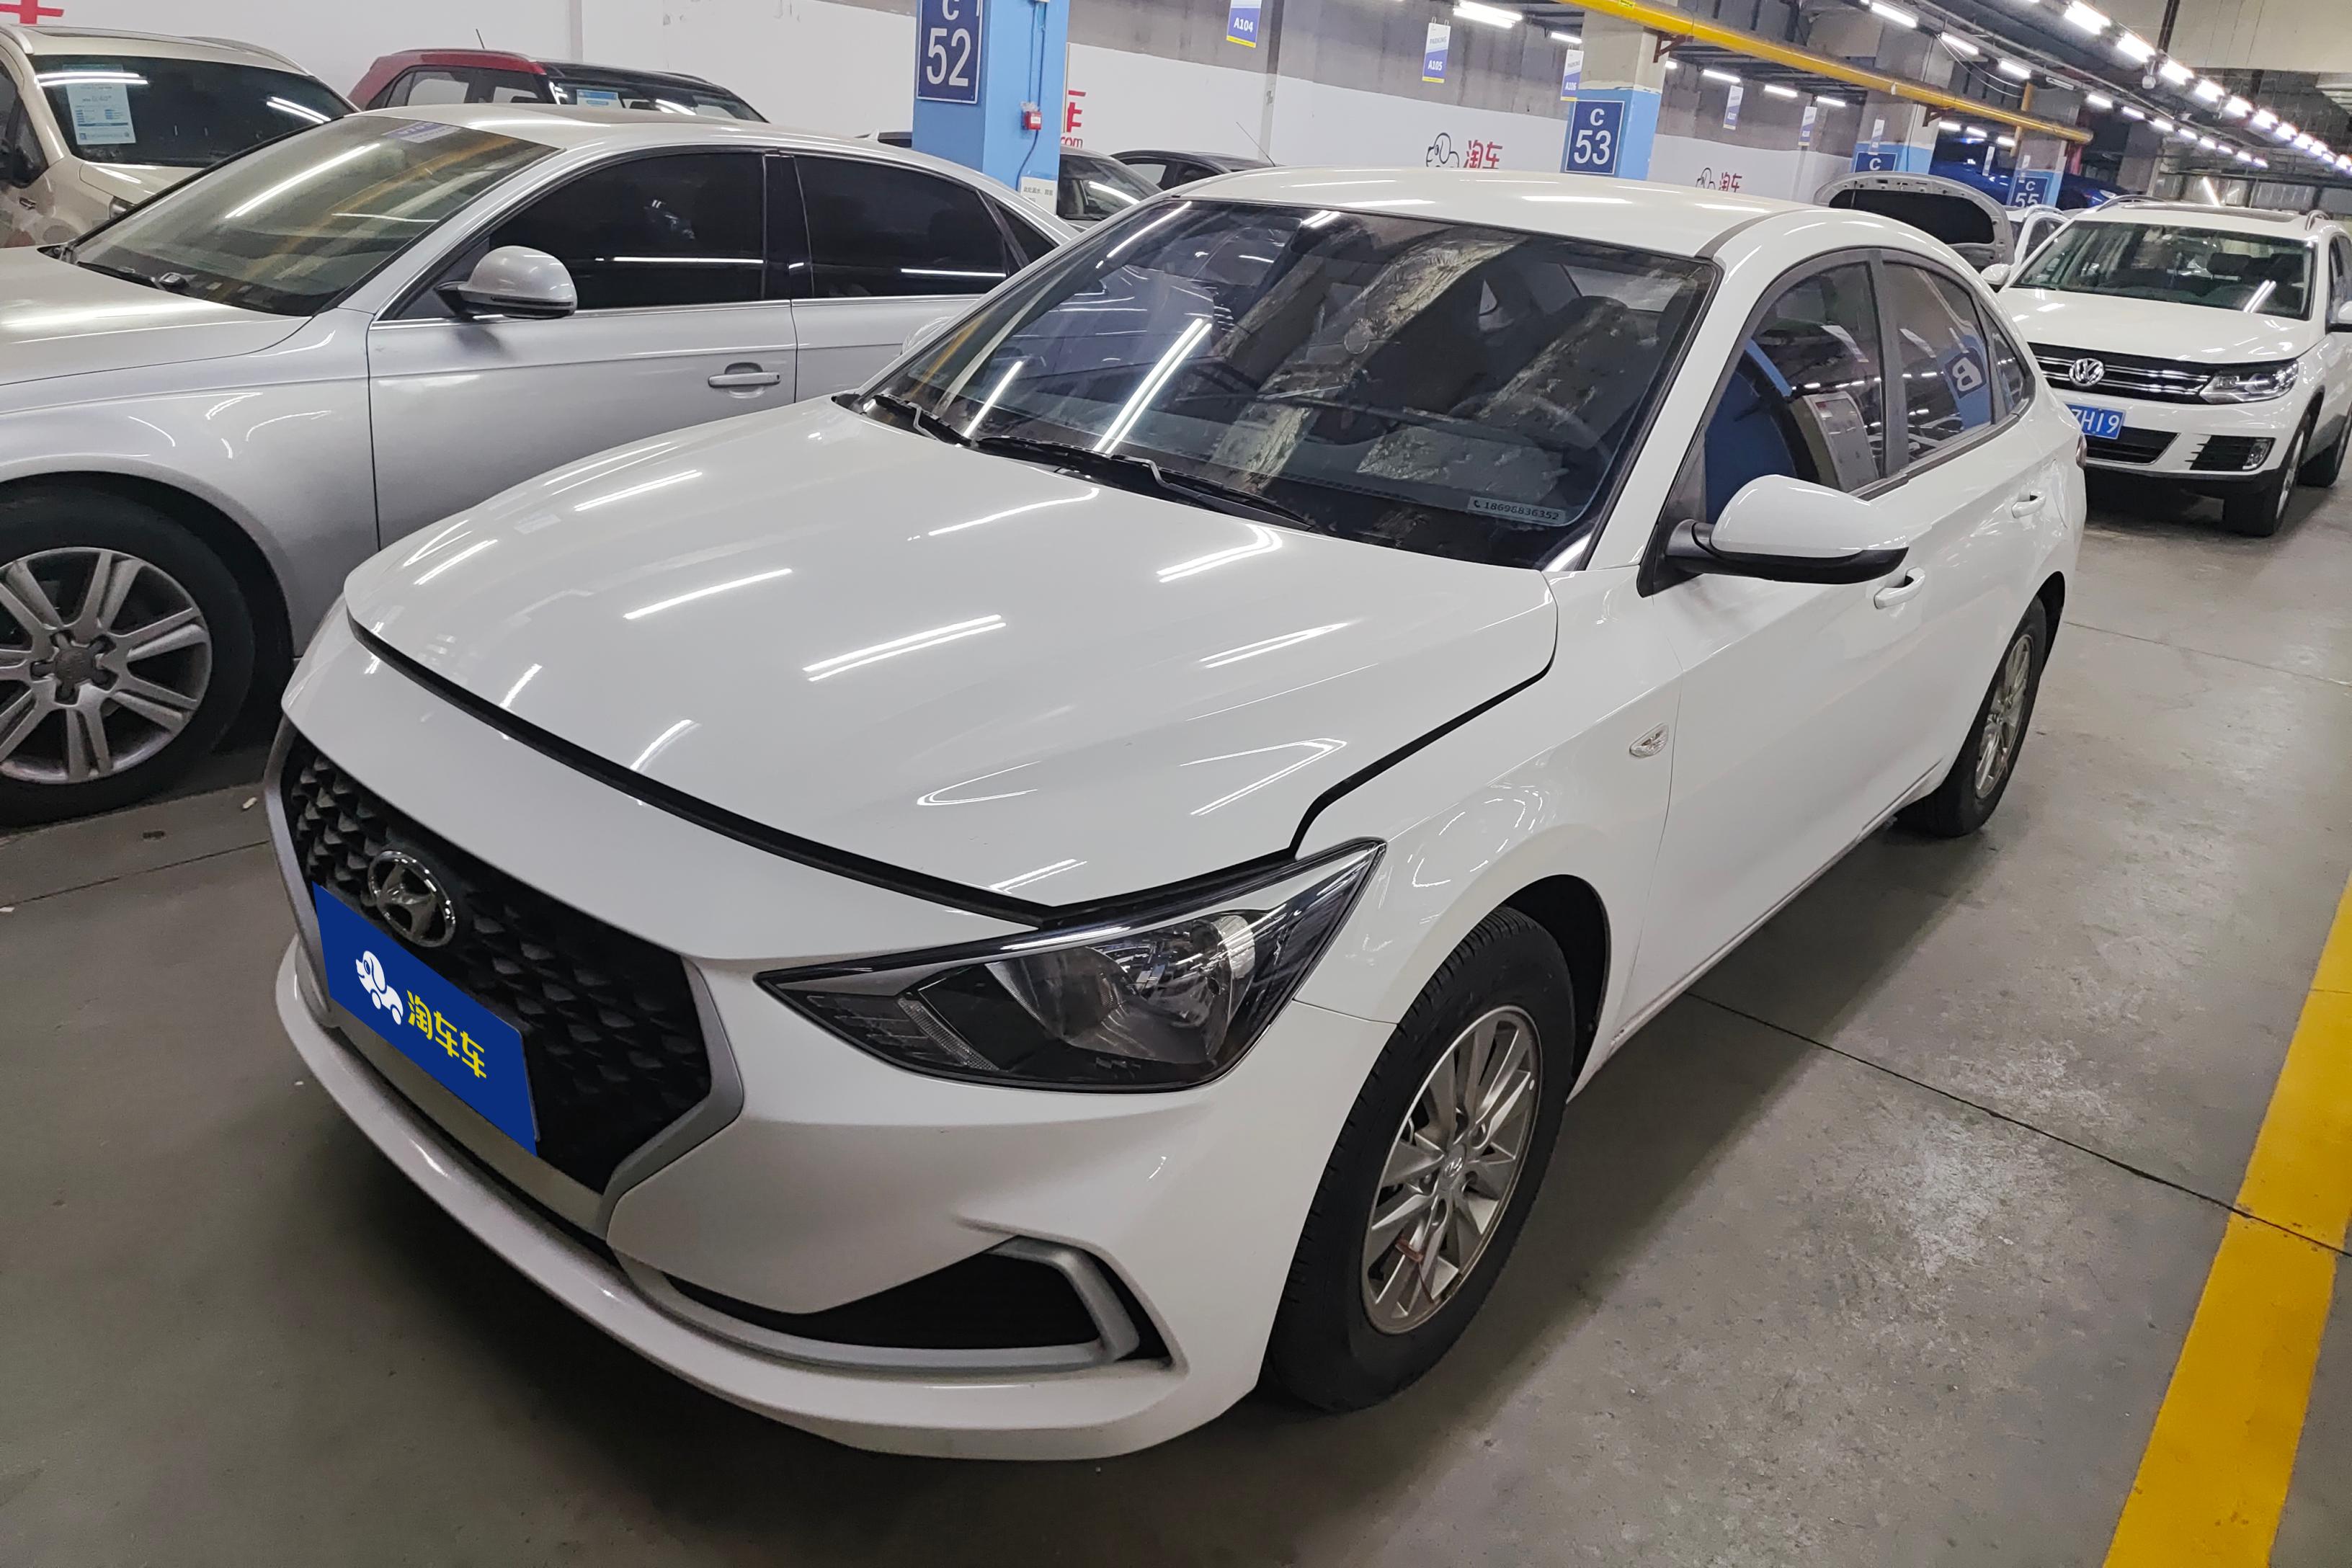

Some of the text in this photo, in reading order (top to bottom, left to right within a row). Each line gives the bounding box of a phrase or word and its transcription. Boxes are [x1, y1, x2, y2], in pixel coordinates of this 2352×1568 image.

[942, 0, 960, 20] C
[1233, 17, 1254, 32] A104
[926, 27, 971, 86] 52
[1427, 60, 1443, 71] A105
[1590, 108, 1605, 126] C
[1464, 140, 1503, 169] 淘车
[1574, 130, 1612, 165] 53
[1869, 158, 1881, 171] C
[2025, 181, 2036, 191] C
[2015, 192, 2039, 208] 55
[1484, 502, 1559, 520] 18698836352
